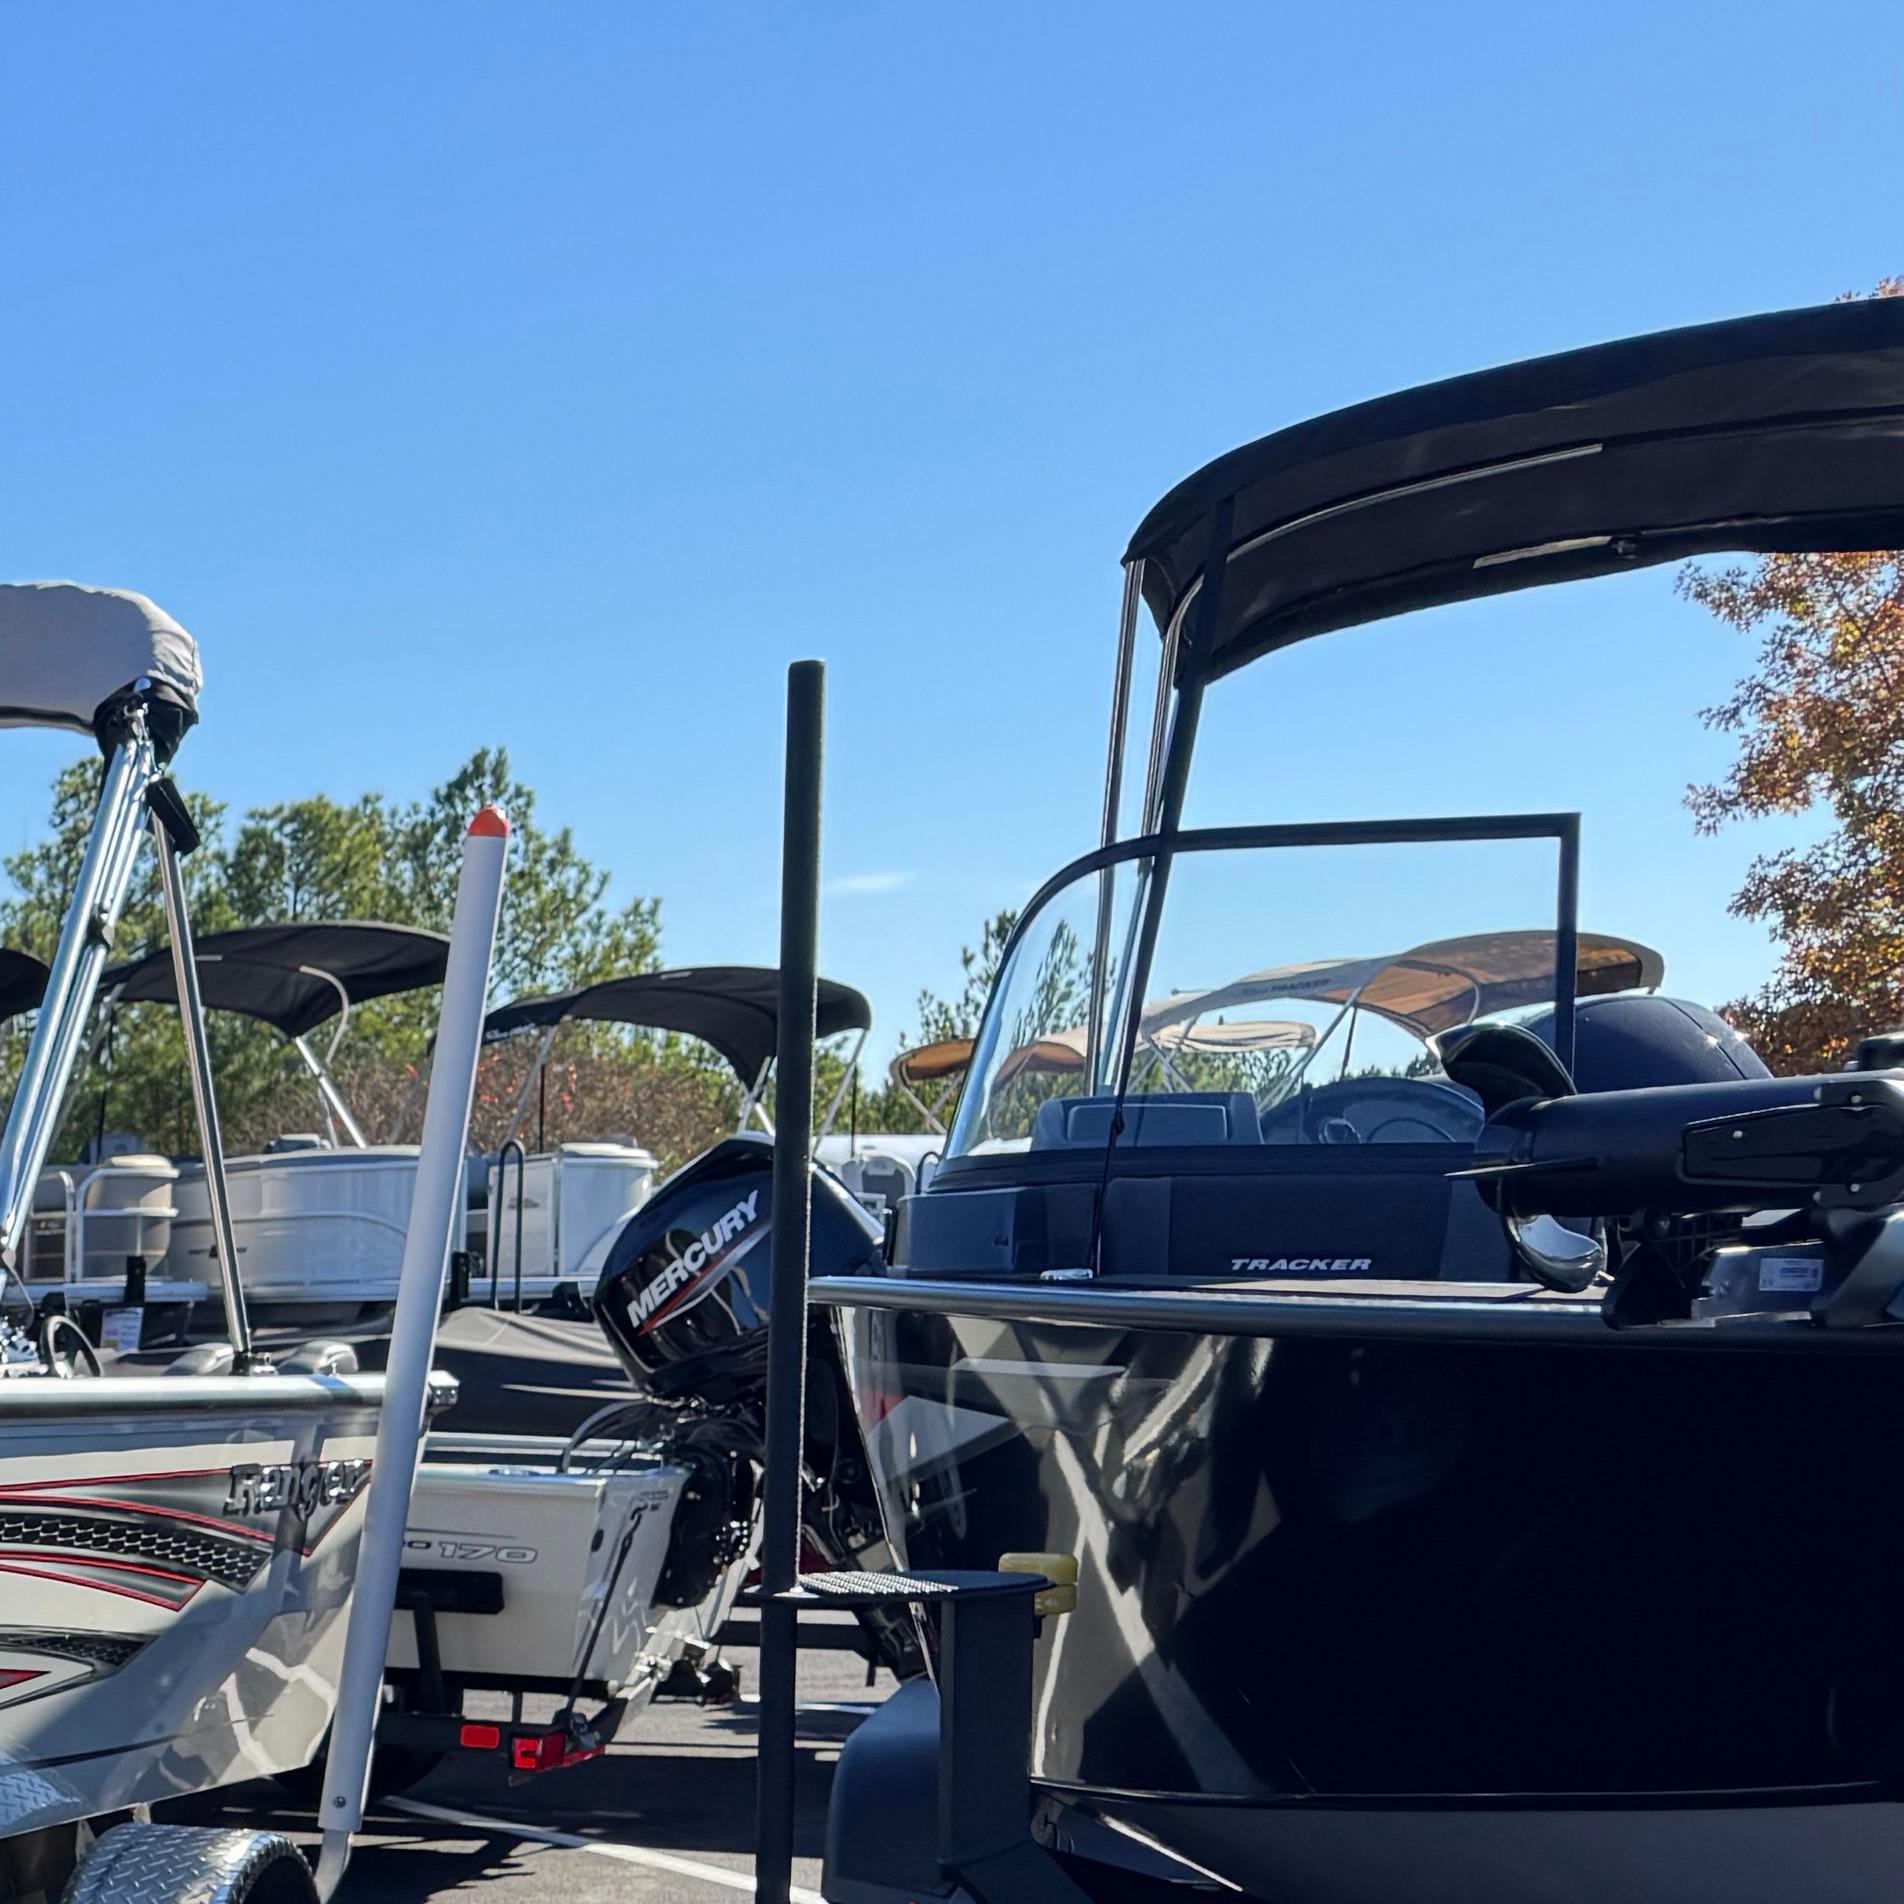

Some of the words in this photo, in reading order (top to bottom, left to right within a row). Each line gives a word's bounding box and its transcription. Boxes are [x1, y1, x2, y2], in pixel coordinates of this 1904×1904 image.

[627, 1190, 758, 1328] MERCURY
[1231, 1258, 1372, 1271] TRACKER
[222, 1459, 369, 1521] Ranger
[438, 1541, 538, 1564] 170
